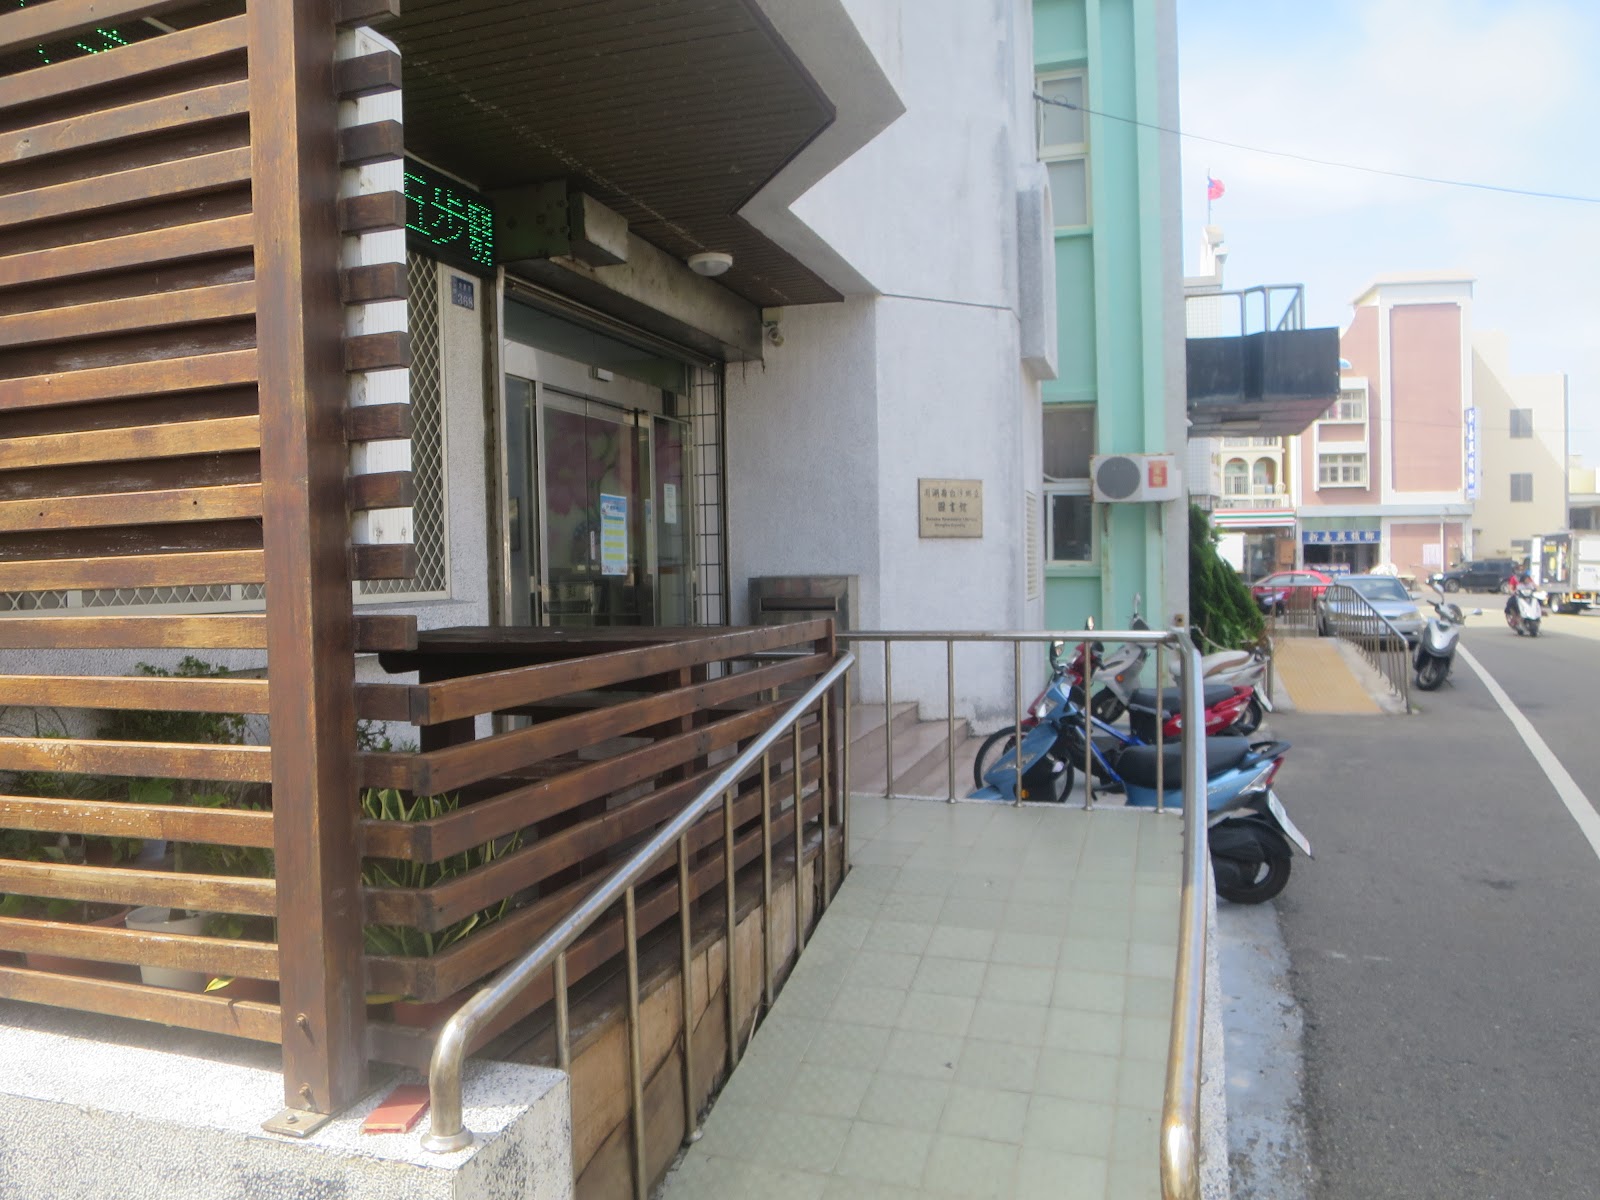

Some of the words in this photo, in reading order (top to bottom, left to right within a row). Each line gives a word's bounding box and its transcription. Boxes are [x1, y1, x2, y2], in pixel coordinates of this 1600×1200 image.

[457, 293, 474, 309] 368
[937, 501, 968, 513] 圖書館
